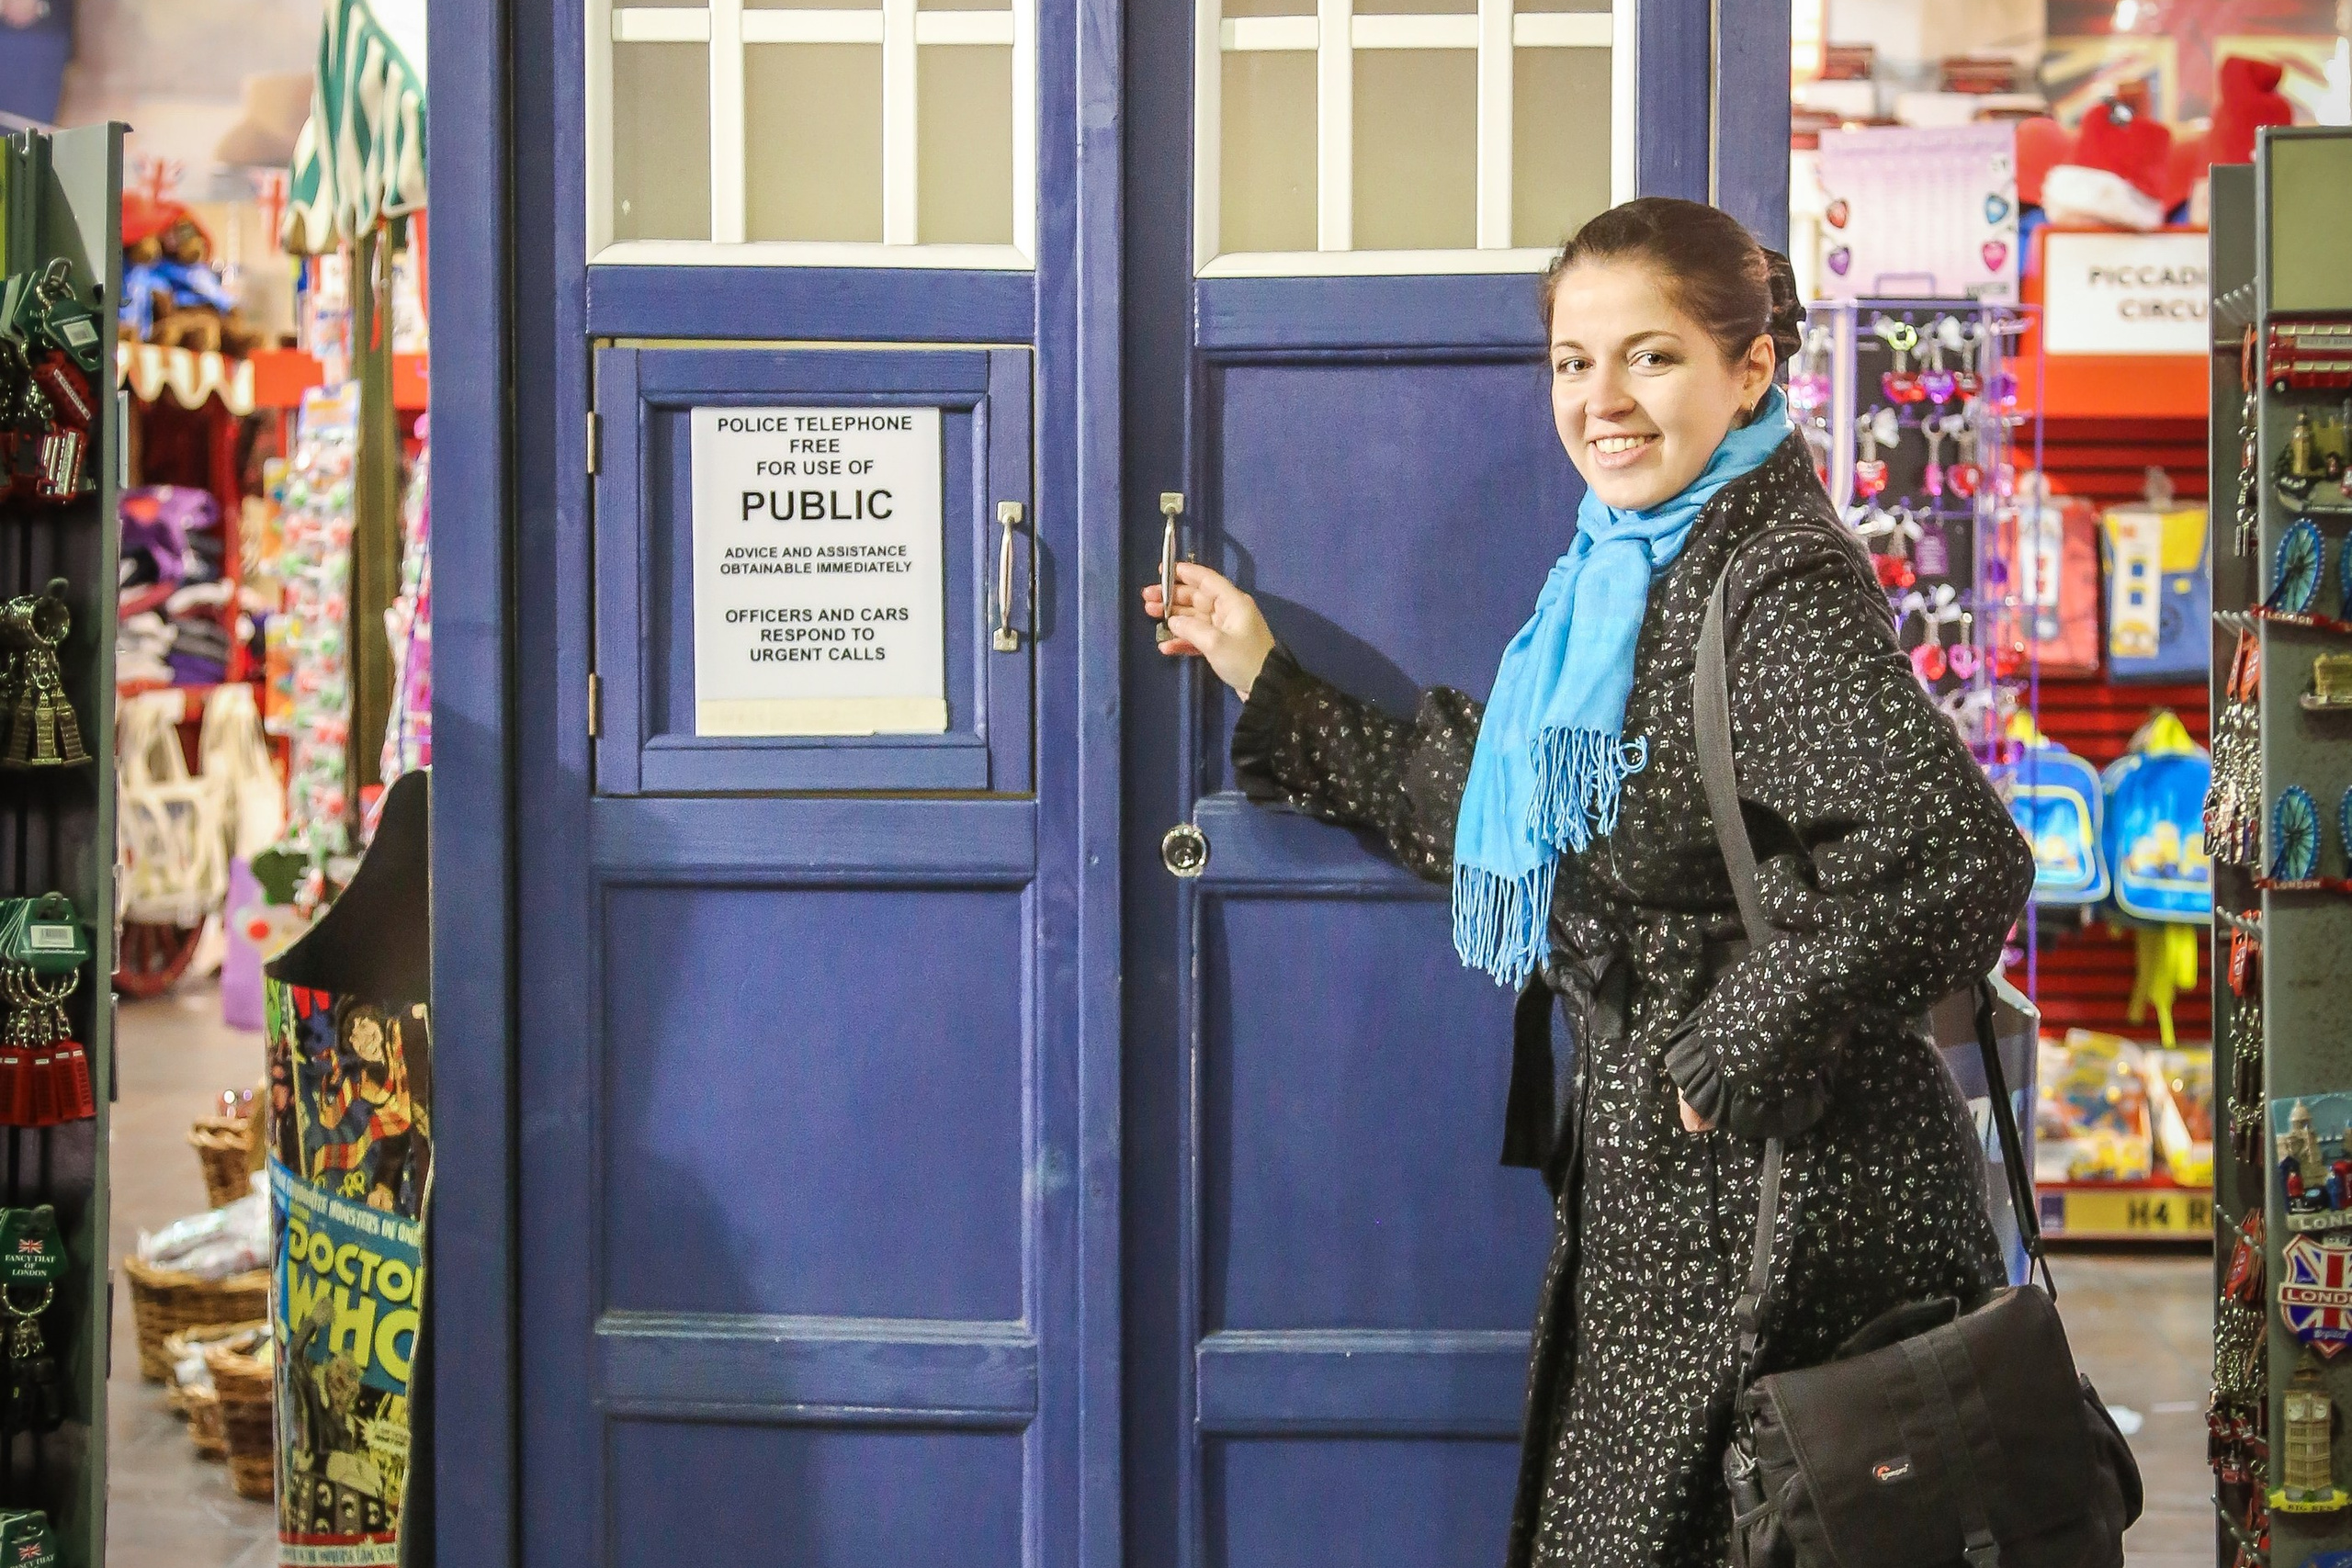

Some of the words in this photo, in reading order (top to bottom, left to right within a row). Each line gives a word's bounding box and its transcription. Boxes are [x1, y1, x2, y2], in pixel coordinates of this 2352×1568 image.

[718, 417, 787, 432] POLICE
[794, 415, 911, 432] TELEPHONE
[789, 438, 839, 453] FREE
[756, 460, 796, 475] FOR
[803, 460, 841, 475] USE
[848, 460, 874, 475] OF
[741, 489, 893, 521] PUBLIC
[725, 547, 777, 558] ADVICE
[782, 547, 812, 558] AND
[817, 546, 907, 558] ASSISTANCE
[720, 562, 812, 574] OBTAINABLE
[816, 561, 912, 574] IMMEDIATELY
[725, 609, 812, 623] OFFICERS
[818, 608, 854, 622] AND
[860, 608, 909, 622] CARS
[761, 628, 845, 642] RESPOND
[851, 628, 875, 641] TO
[750, 648, 823, 661] URGENT
[828, 647, 886, 660] CALLS
[5, 1254, 31, 1262] FANCY
[33, 1255, 56, 1263] THAT
[289, 1217, 423, 1308] DOCTO
[12, 1269, 47, 1277] LONDON
[2287, 1288, 2352, 1303] LOND
